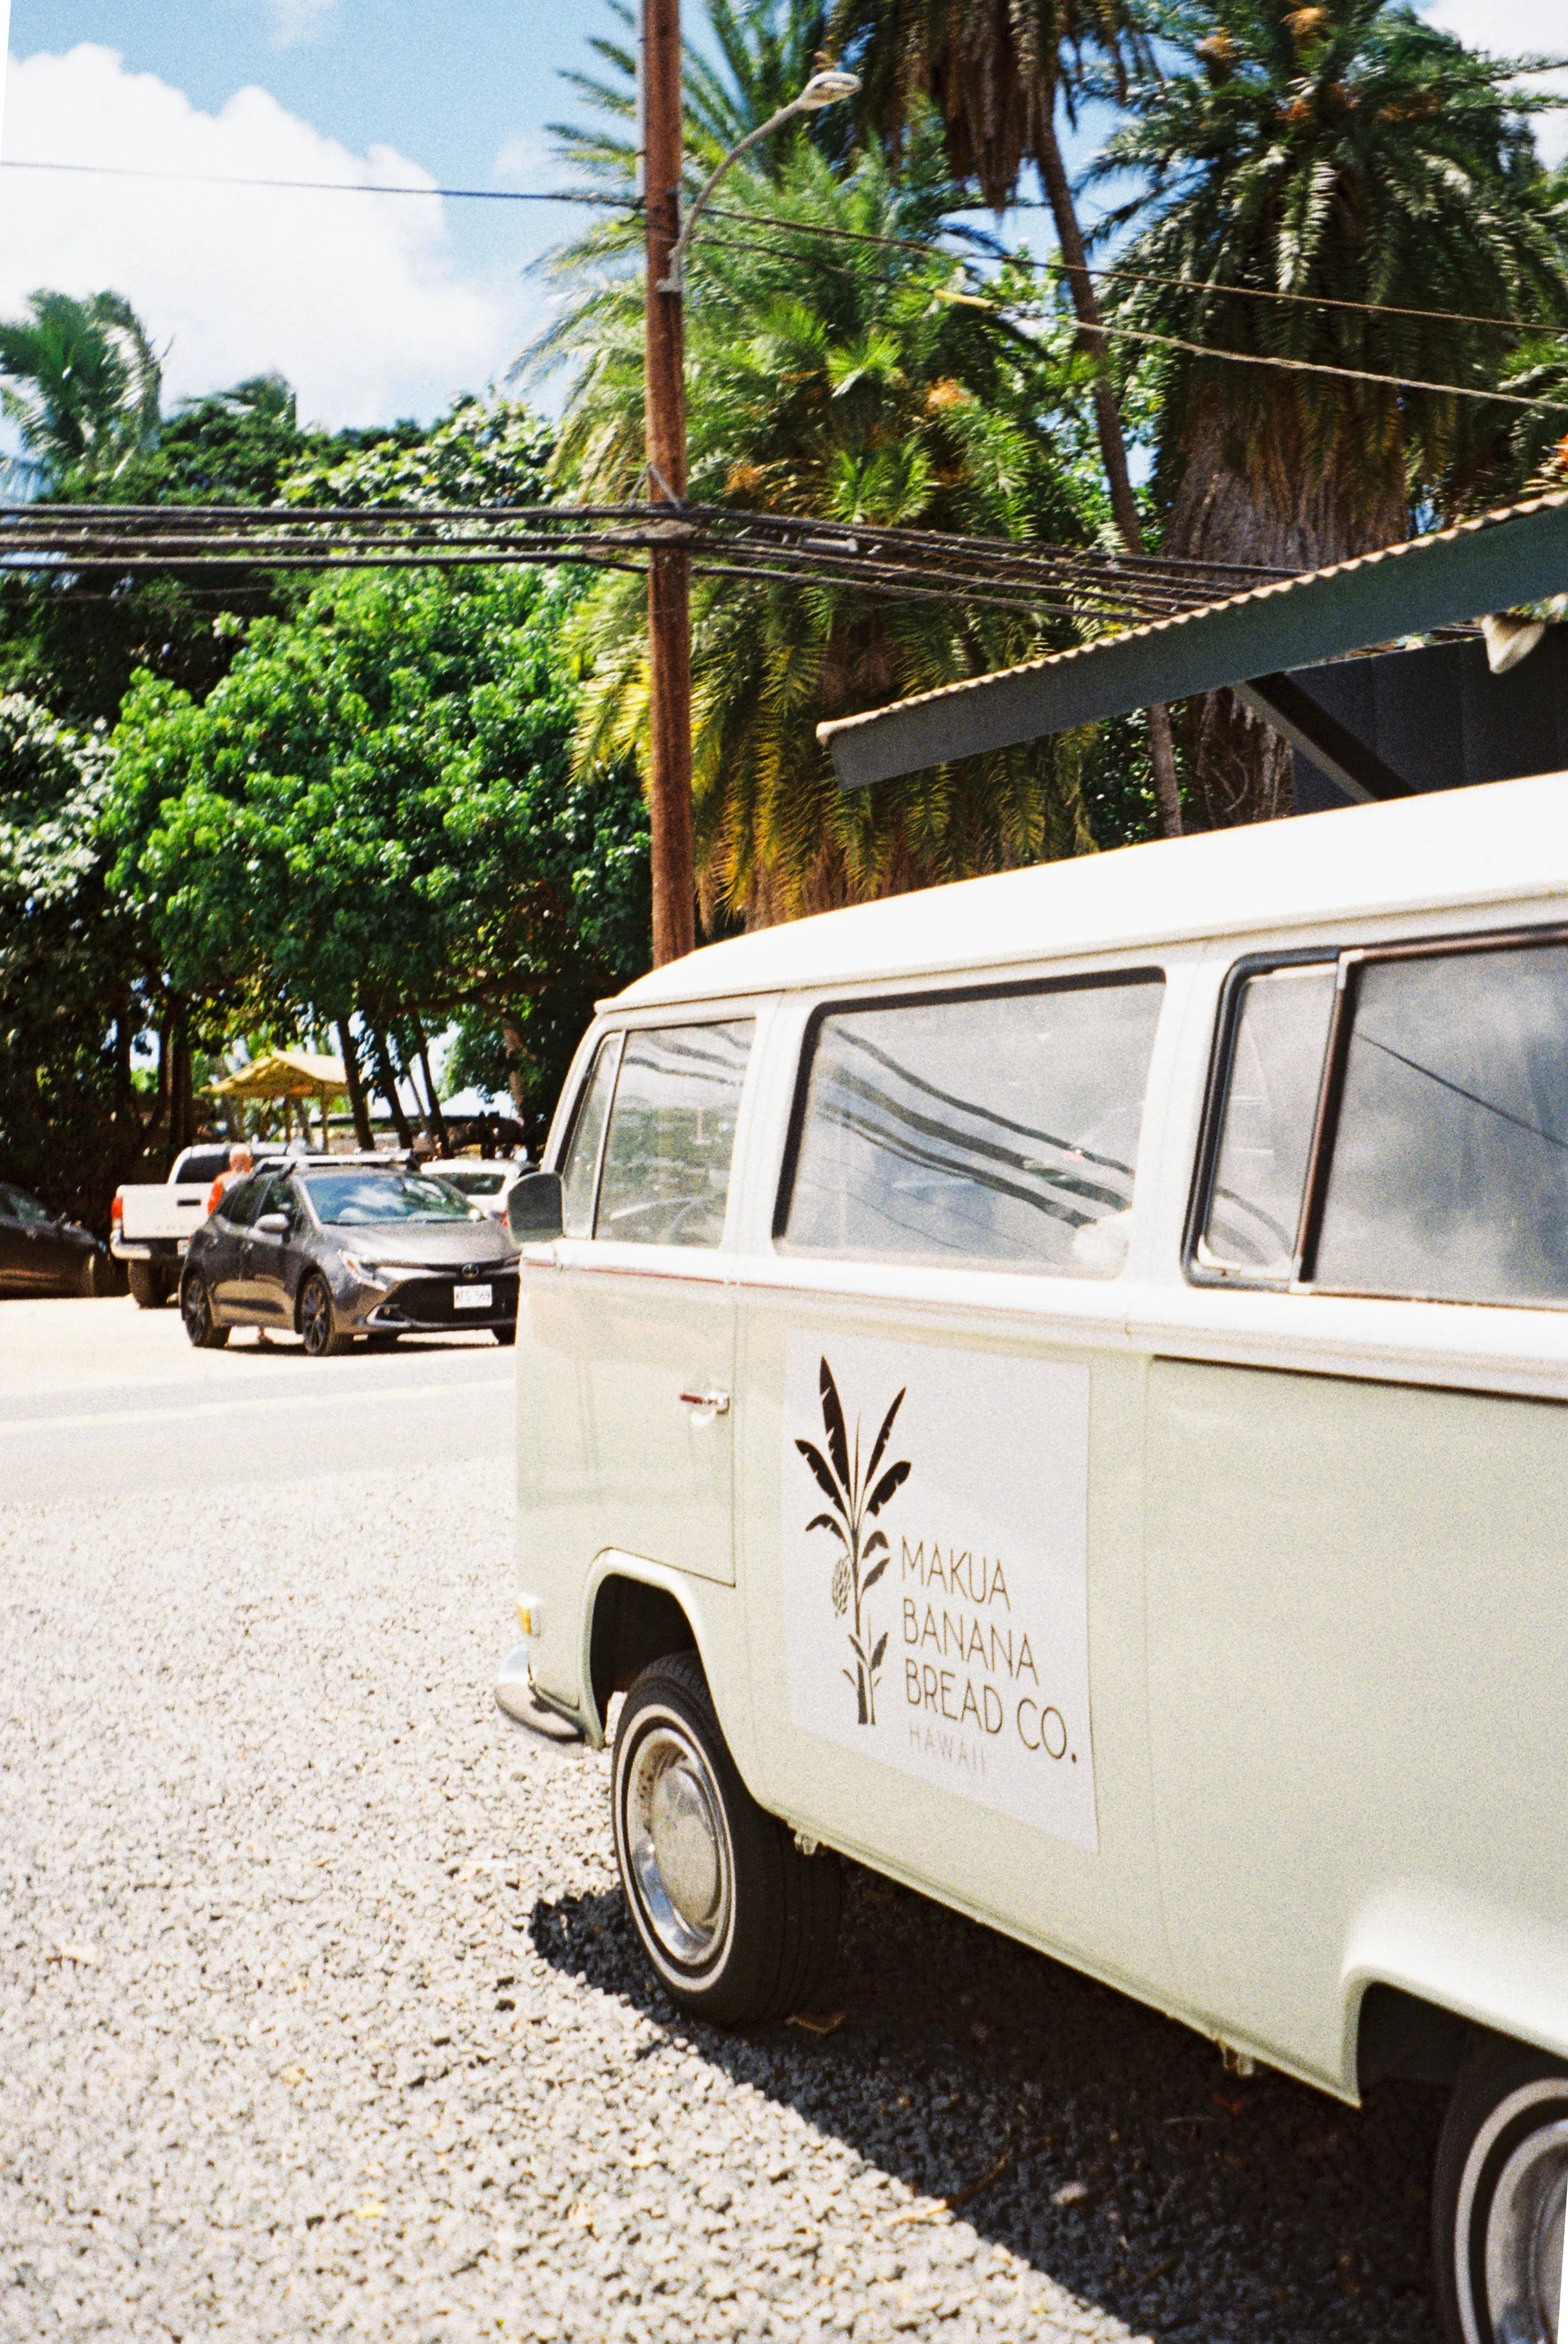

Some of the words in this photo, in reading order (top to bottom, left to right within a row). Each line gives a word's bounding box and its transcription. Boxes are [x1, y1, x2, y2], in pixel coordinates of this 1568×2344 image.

[902, 1535, 1011, 1612] MAKUA
[904, 1596, 1040, 1687] BANANA
[905, 1657, 1003, 1734] BREAD
[1016, 1697, 1078, 1764] CO.
[909, 1719, 985, 1776] HAWAII
